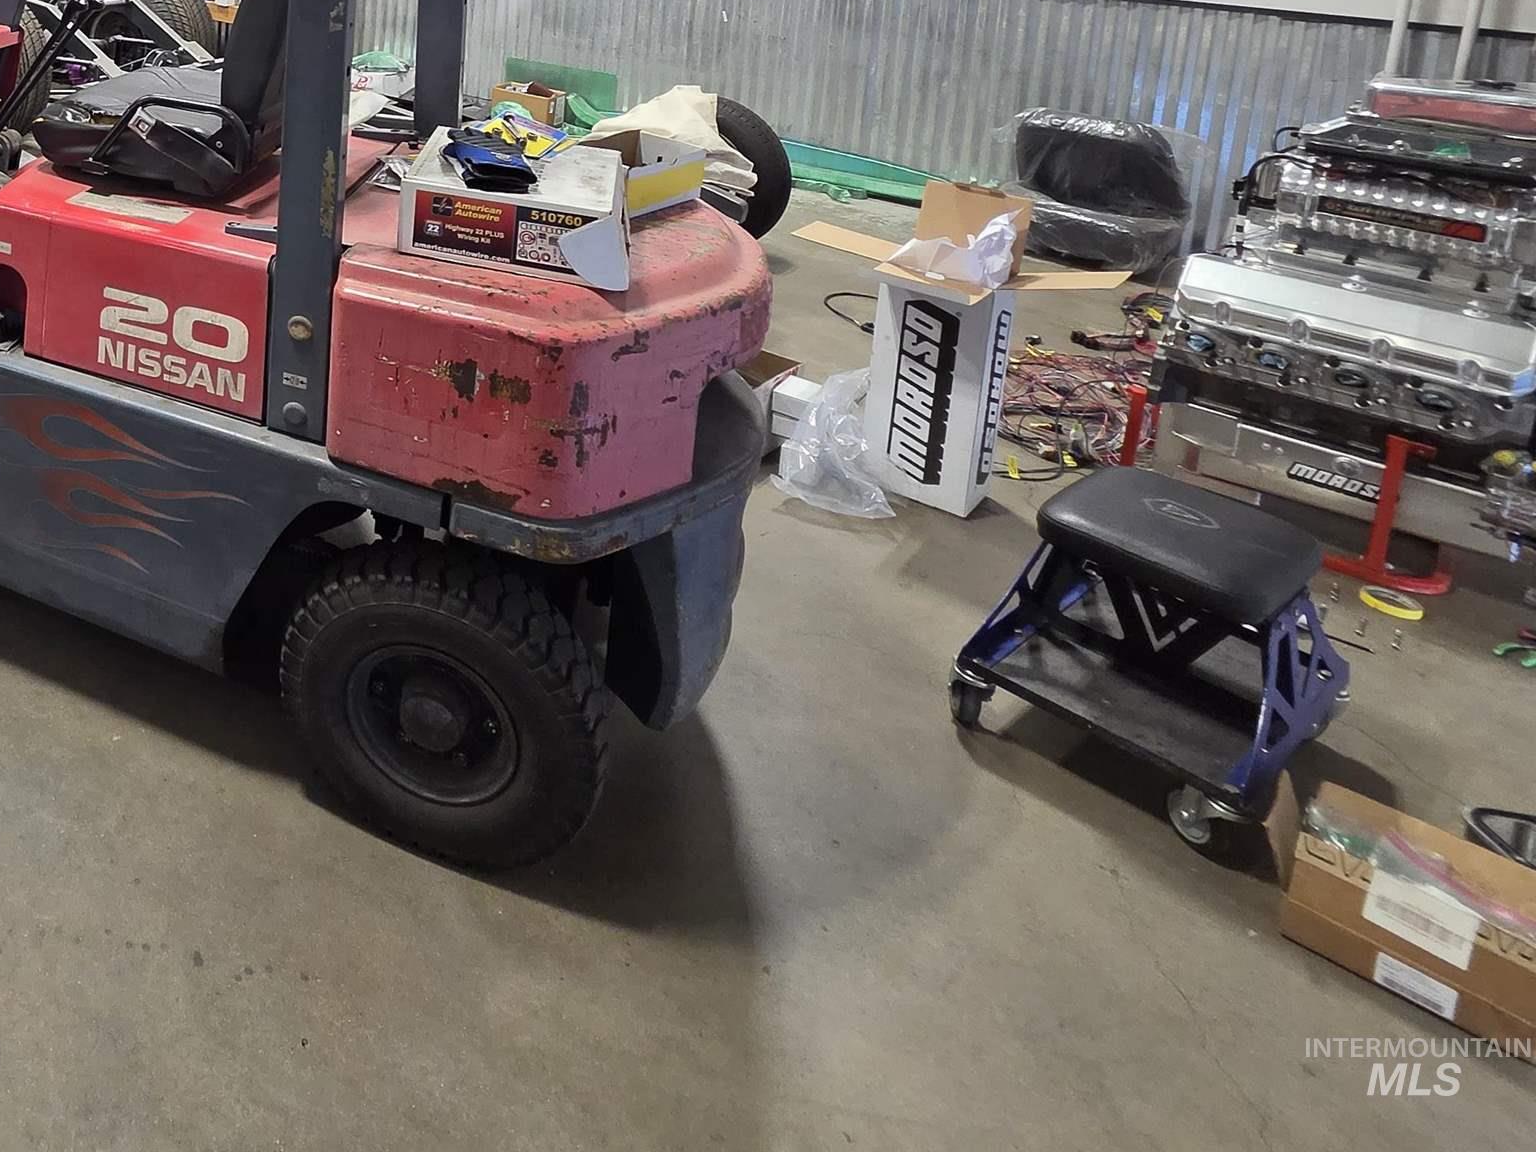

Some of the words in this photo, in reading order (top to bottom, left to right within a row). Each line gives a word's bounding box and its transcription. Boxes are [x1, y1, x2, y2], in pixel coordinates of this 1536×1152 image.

[454, 201, 503, 215] American
[455, 209, 501, 223] Autowire
[427, 223, 440, 233] 22
[530, 210, 582, 227] 510760
[444, 223, 474, 235] Highway
[484, 230, 505, 239] PLUS
[457, 233, 480, 244] Wiring
[413, 241, 511, 264] americanautowire.com
[99, 285, 250, 364] 20
[97, 335, 247, 403] NISSAN
[888, 300, 948, 483] MOROSO
[979, 311, 1012, 477] MOROSO
[1288, 462, 1382, 501] MOROS
